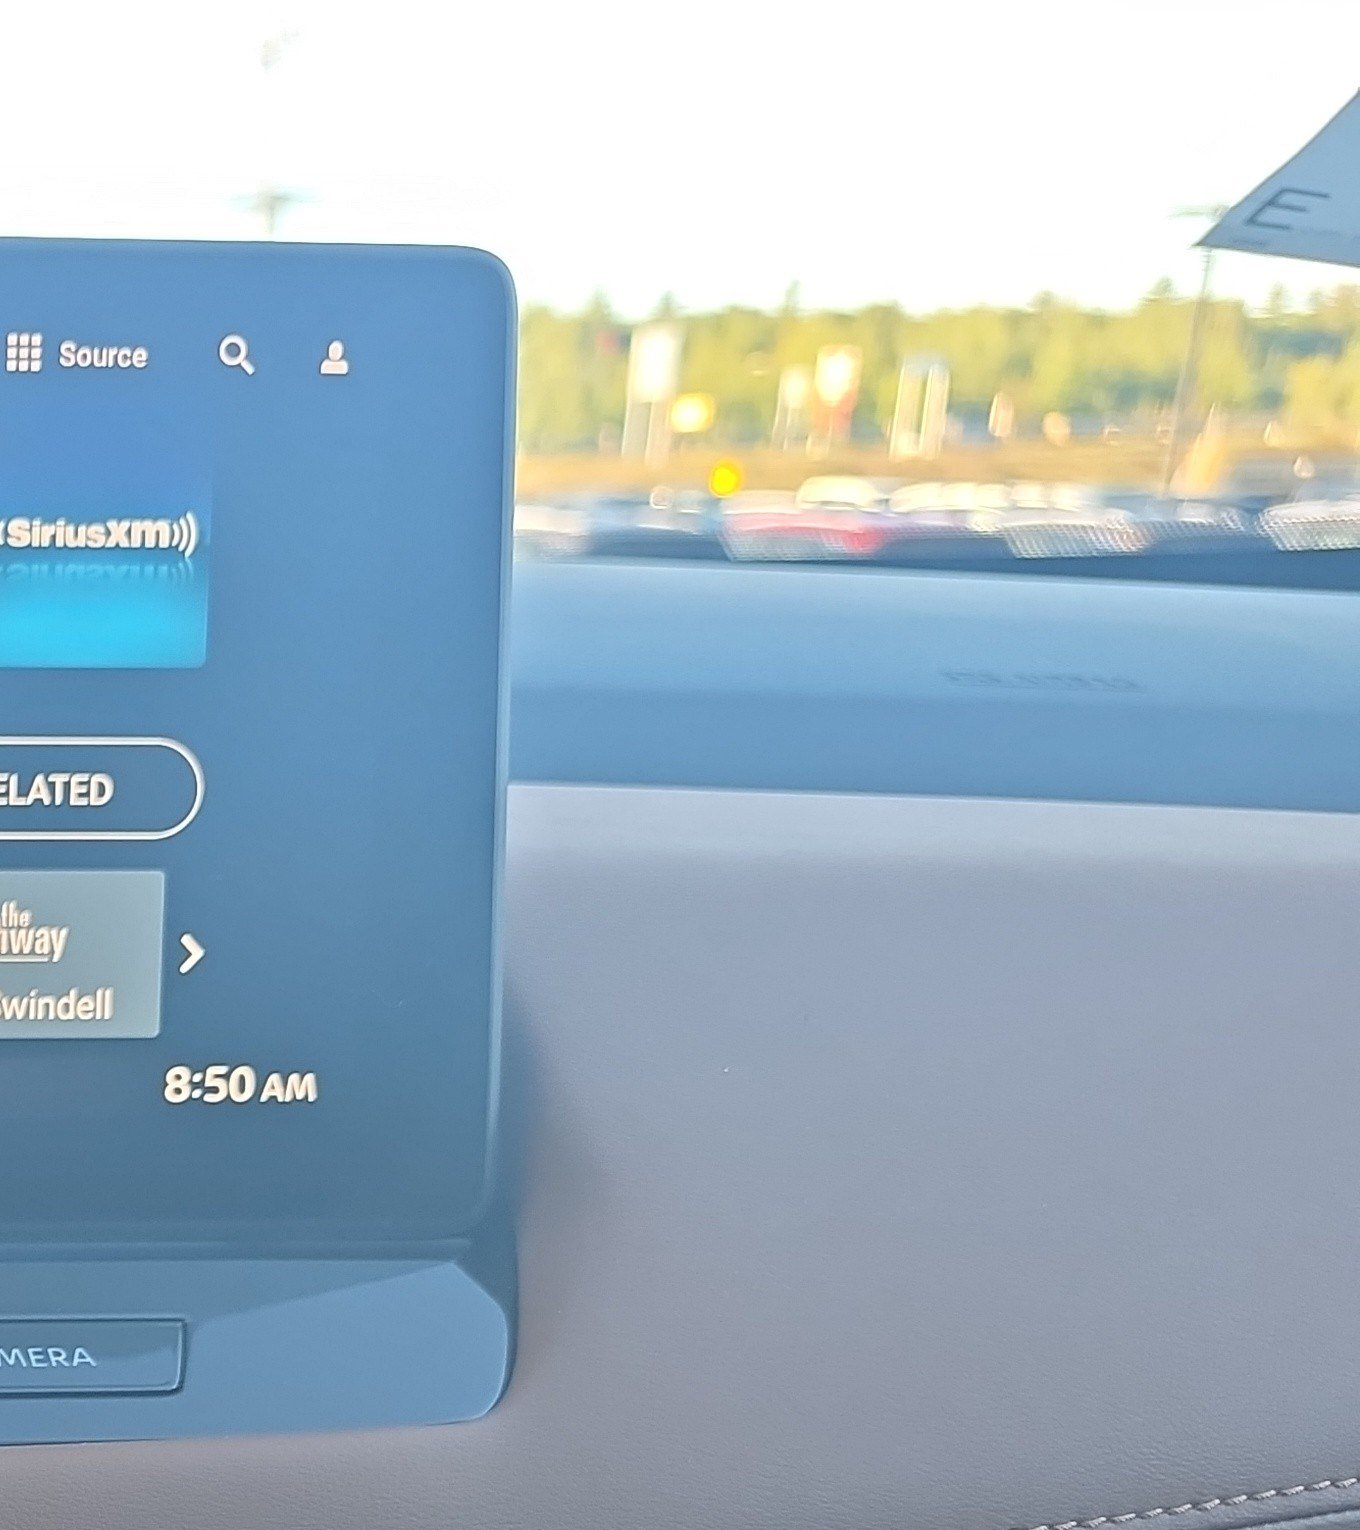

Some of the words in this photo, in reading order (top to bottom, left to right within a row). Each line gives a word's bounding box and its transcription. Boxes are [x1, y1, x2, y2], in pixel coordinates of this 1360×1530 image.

[58, 341, 148, 369] Source
[0, 900, 32, 928] the
[164, 1064, 256, 1103] 8:50
[260, 1072, 317, 1103] AM
